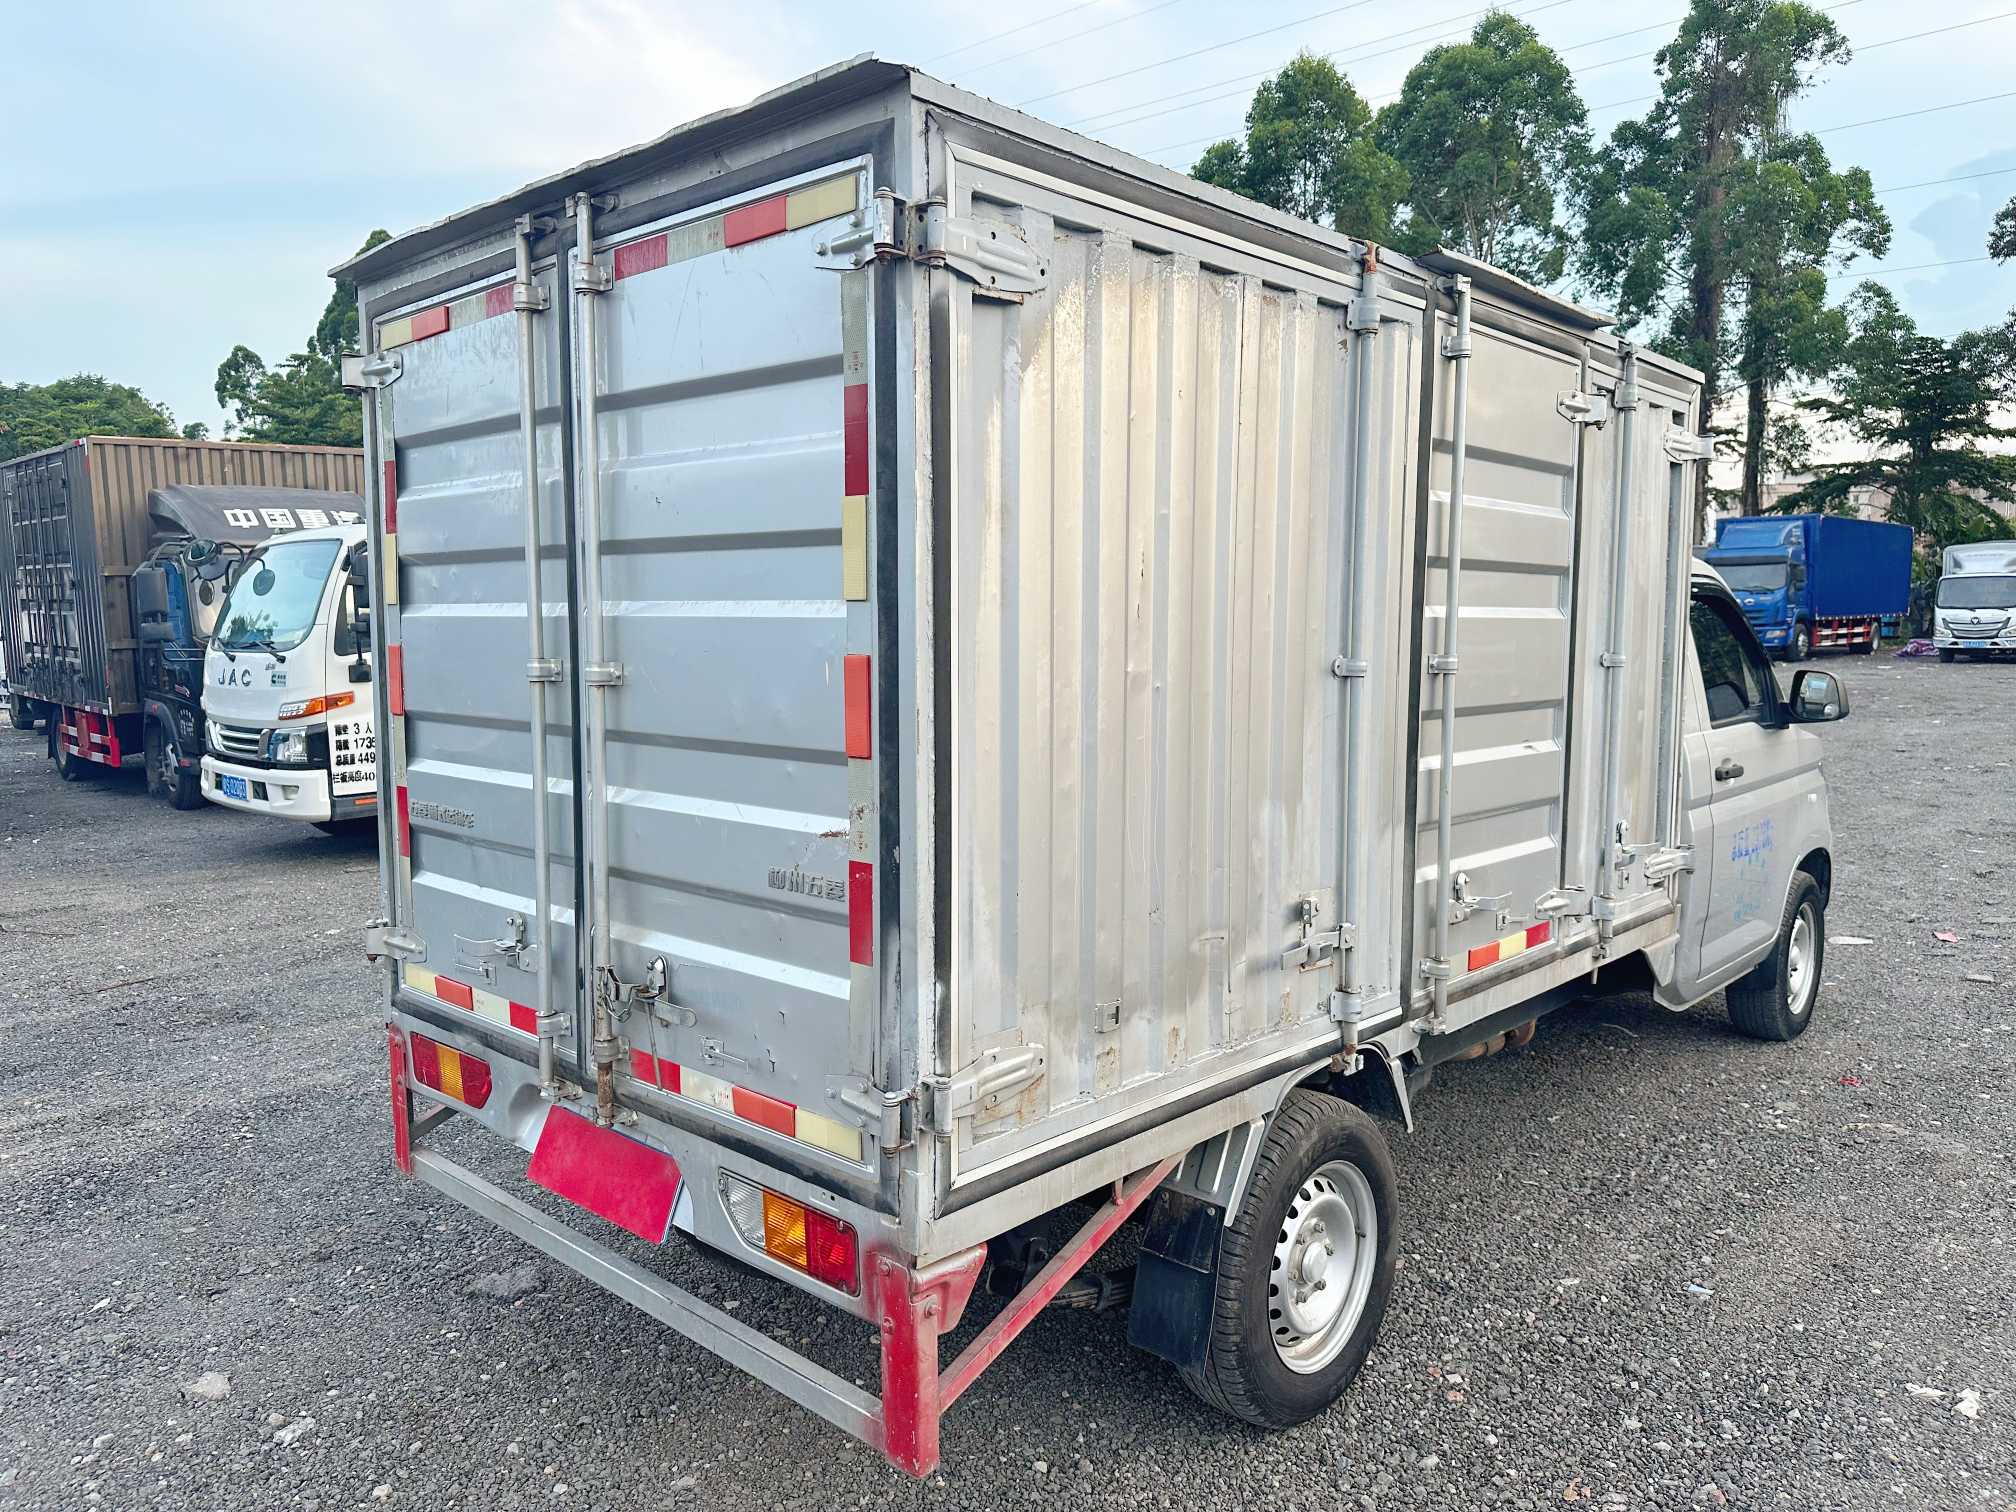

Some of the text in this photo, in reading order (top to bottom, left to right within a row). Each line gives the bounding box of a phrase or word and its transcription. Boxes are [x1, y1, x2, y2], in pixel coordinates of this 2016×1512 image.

[218, 667, 251, 687] JAC
[353, 722, 360, 735] 3
[365, 721, 373, 734] 人
